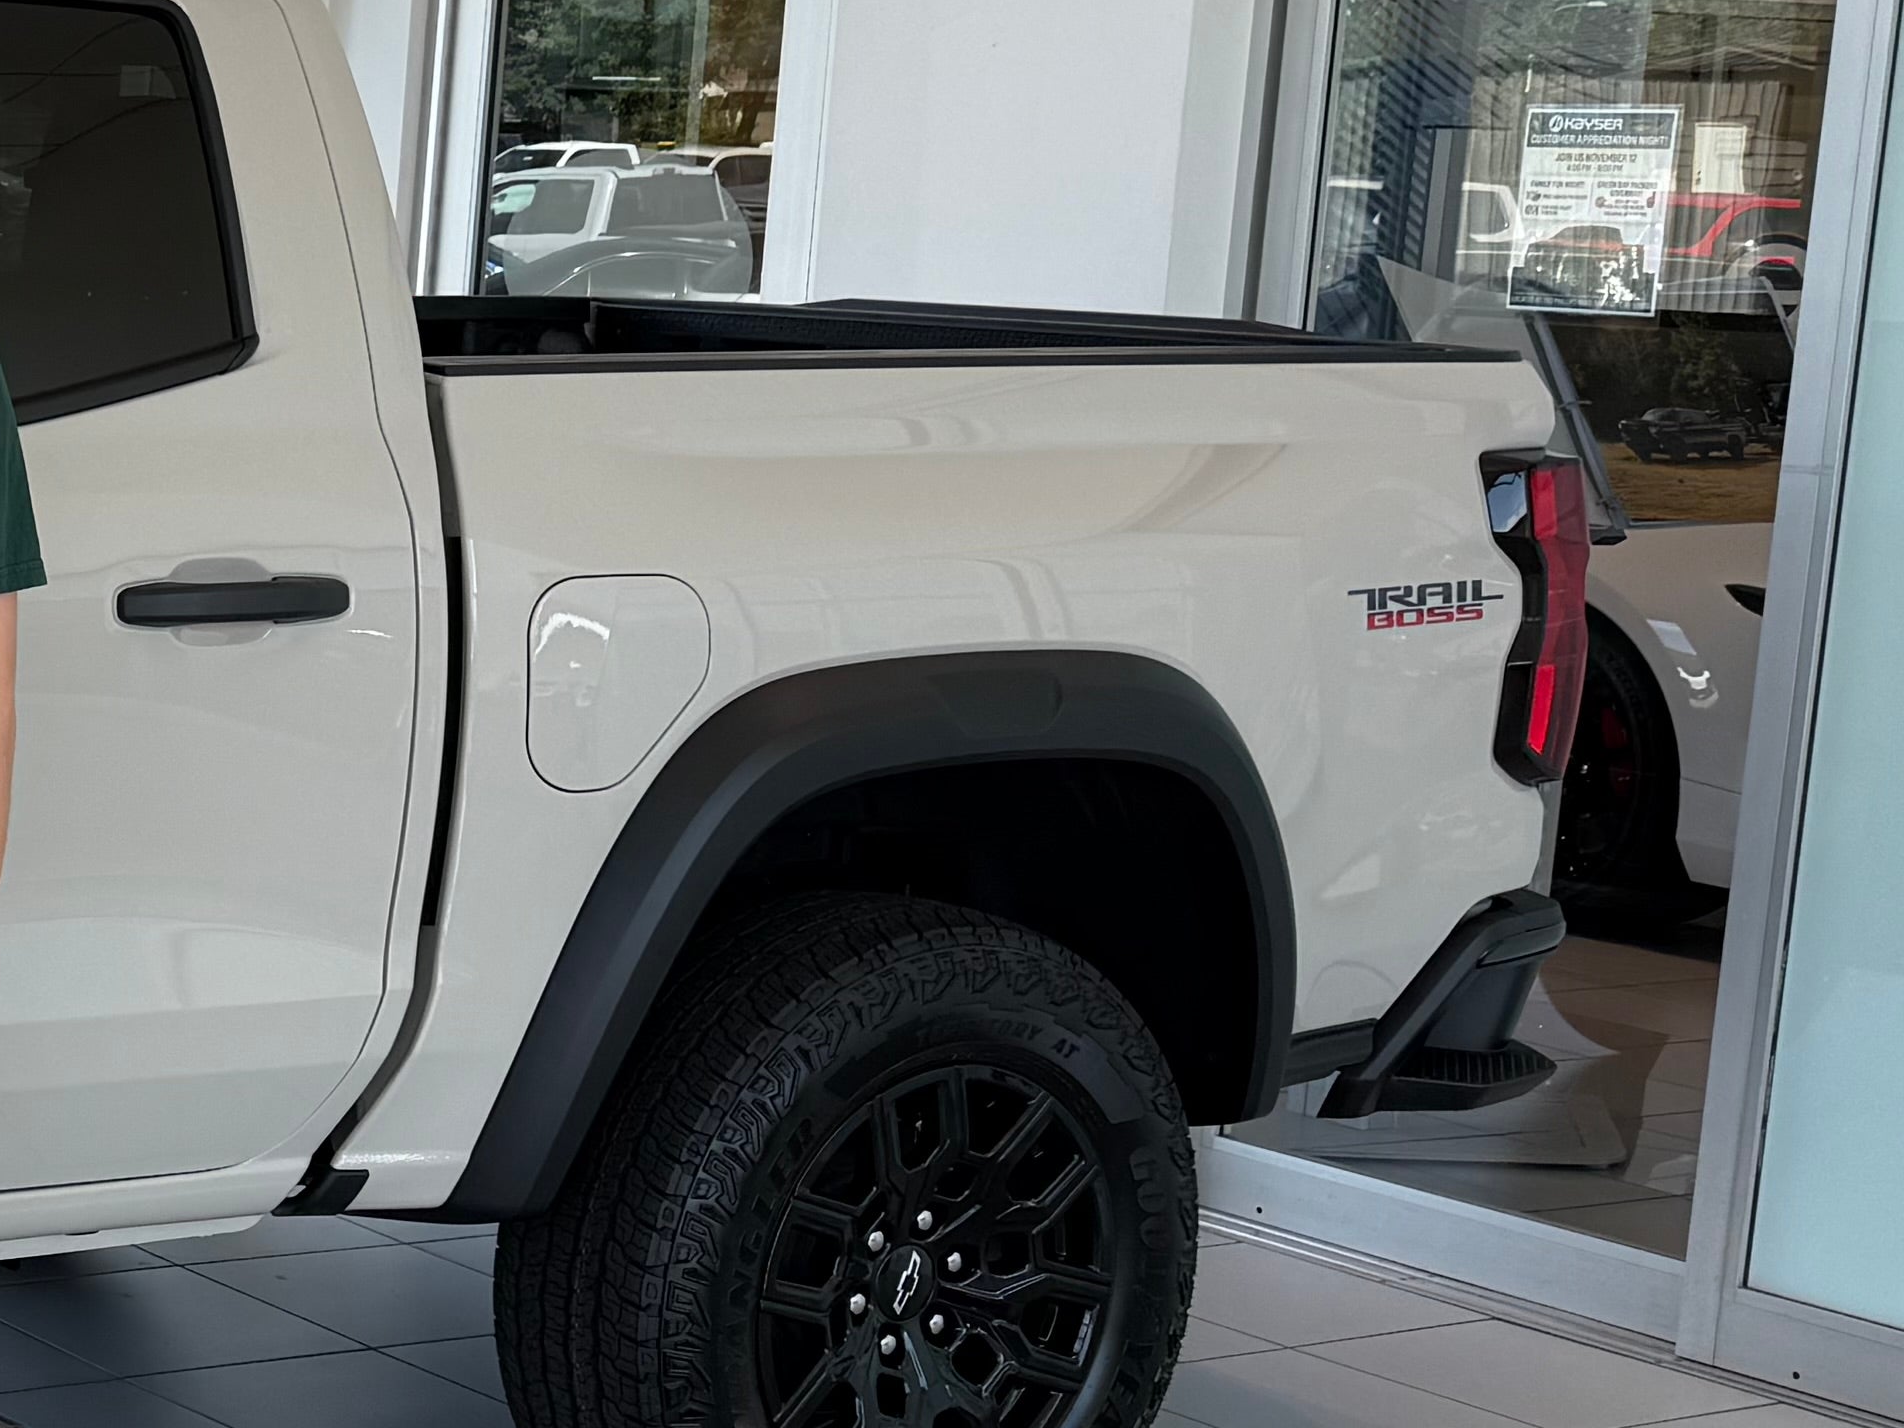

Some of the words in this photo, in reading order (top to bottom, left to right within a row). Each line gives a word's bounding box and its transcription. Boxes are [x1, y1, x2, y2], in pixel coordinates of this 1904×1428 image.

[1531, 134, 1575, 144] CUSTOMER
[1577, 135, 1637, 145] APPRECIATION
[1555, 153, 1573, 162] JOIN
[1585, 153, 1627, 163] NOVEMBER
[1348, 580, 1504, 611] TRAIL
[1366, 603, 1484, 630] BOSS
